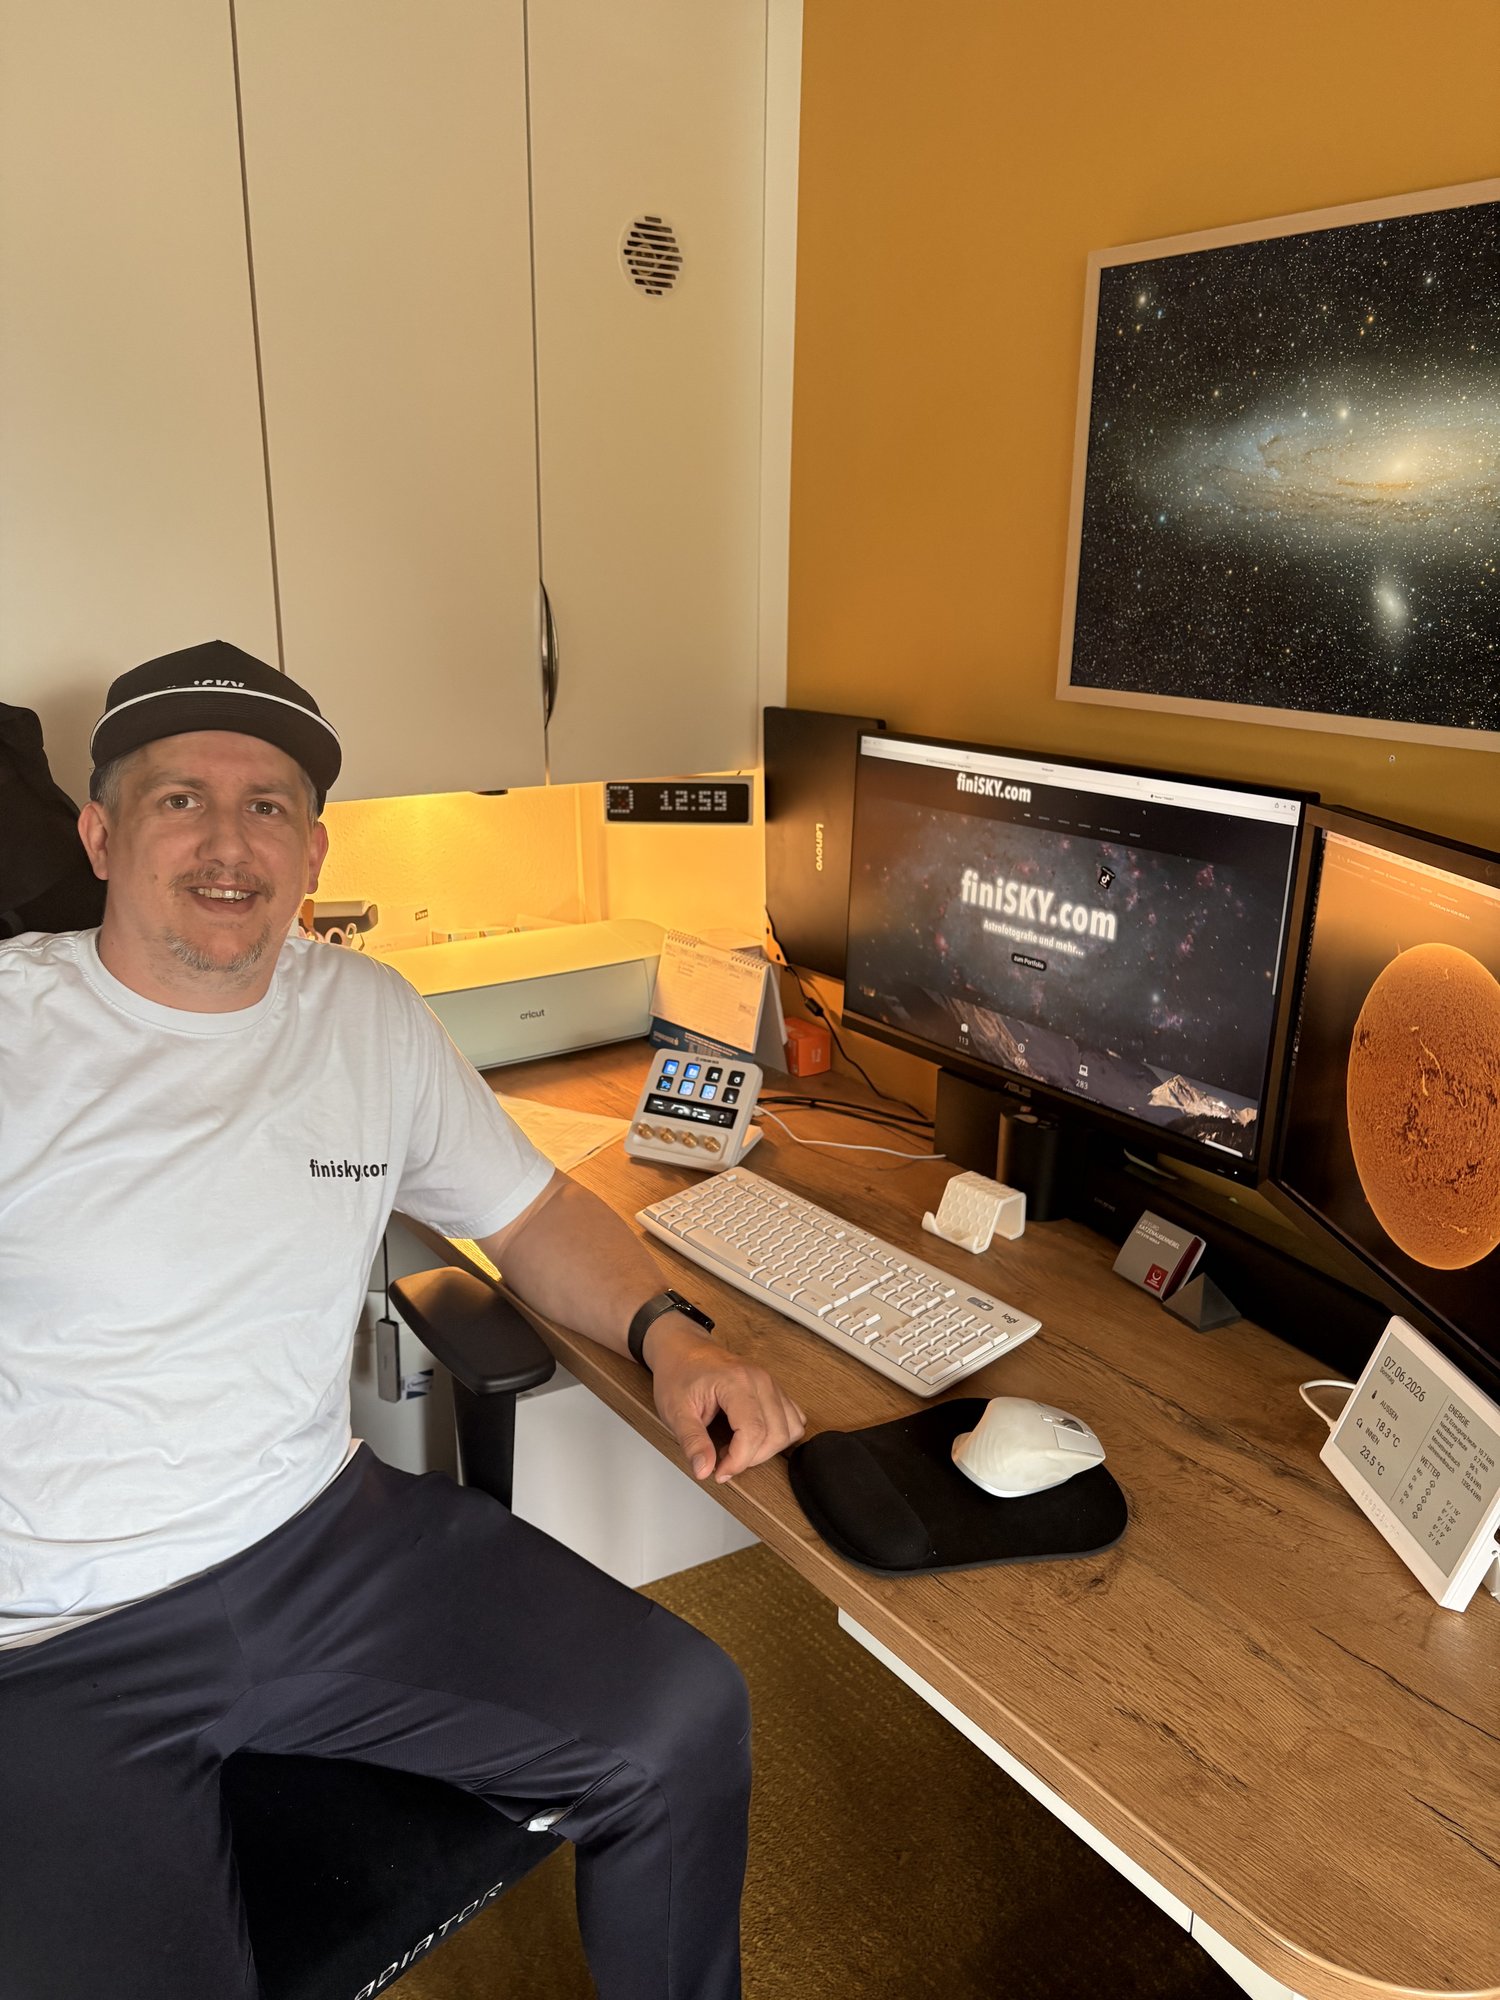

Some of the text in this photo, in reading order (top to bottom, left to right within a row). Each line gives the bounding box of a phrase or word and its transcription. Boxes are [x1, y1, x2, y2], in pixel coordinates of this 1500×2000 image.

[660, 790, 727, 811] 12:59
[956, 772, 1032, 803] finiSKY.com
[815, 823, 824, 871] Lenovo
[961, 869, 1117, 941] finiSKY.com
[983, 919, 1037, 943] Astrofotografie
[1038, 935, 1054, 948] und
[520, 1009, 545, 1020] cricut
[1075, 1079, 1088, 1090] 283
[1001, 1312, 1020, 1324] logi
[1383, 1355, 1427, 1403] 07.06.2026
[1379, 1400, 1399, 1422] AUSSEN
[1447, 1403, 1471, 1428] ENERGIE
[1375, 1417, 1401, 1448] 18.3 °C
[1359, 1445, 1385, 1476] 23.5 °C
[1420, 1455, 1441, 1480] WETTER
